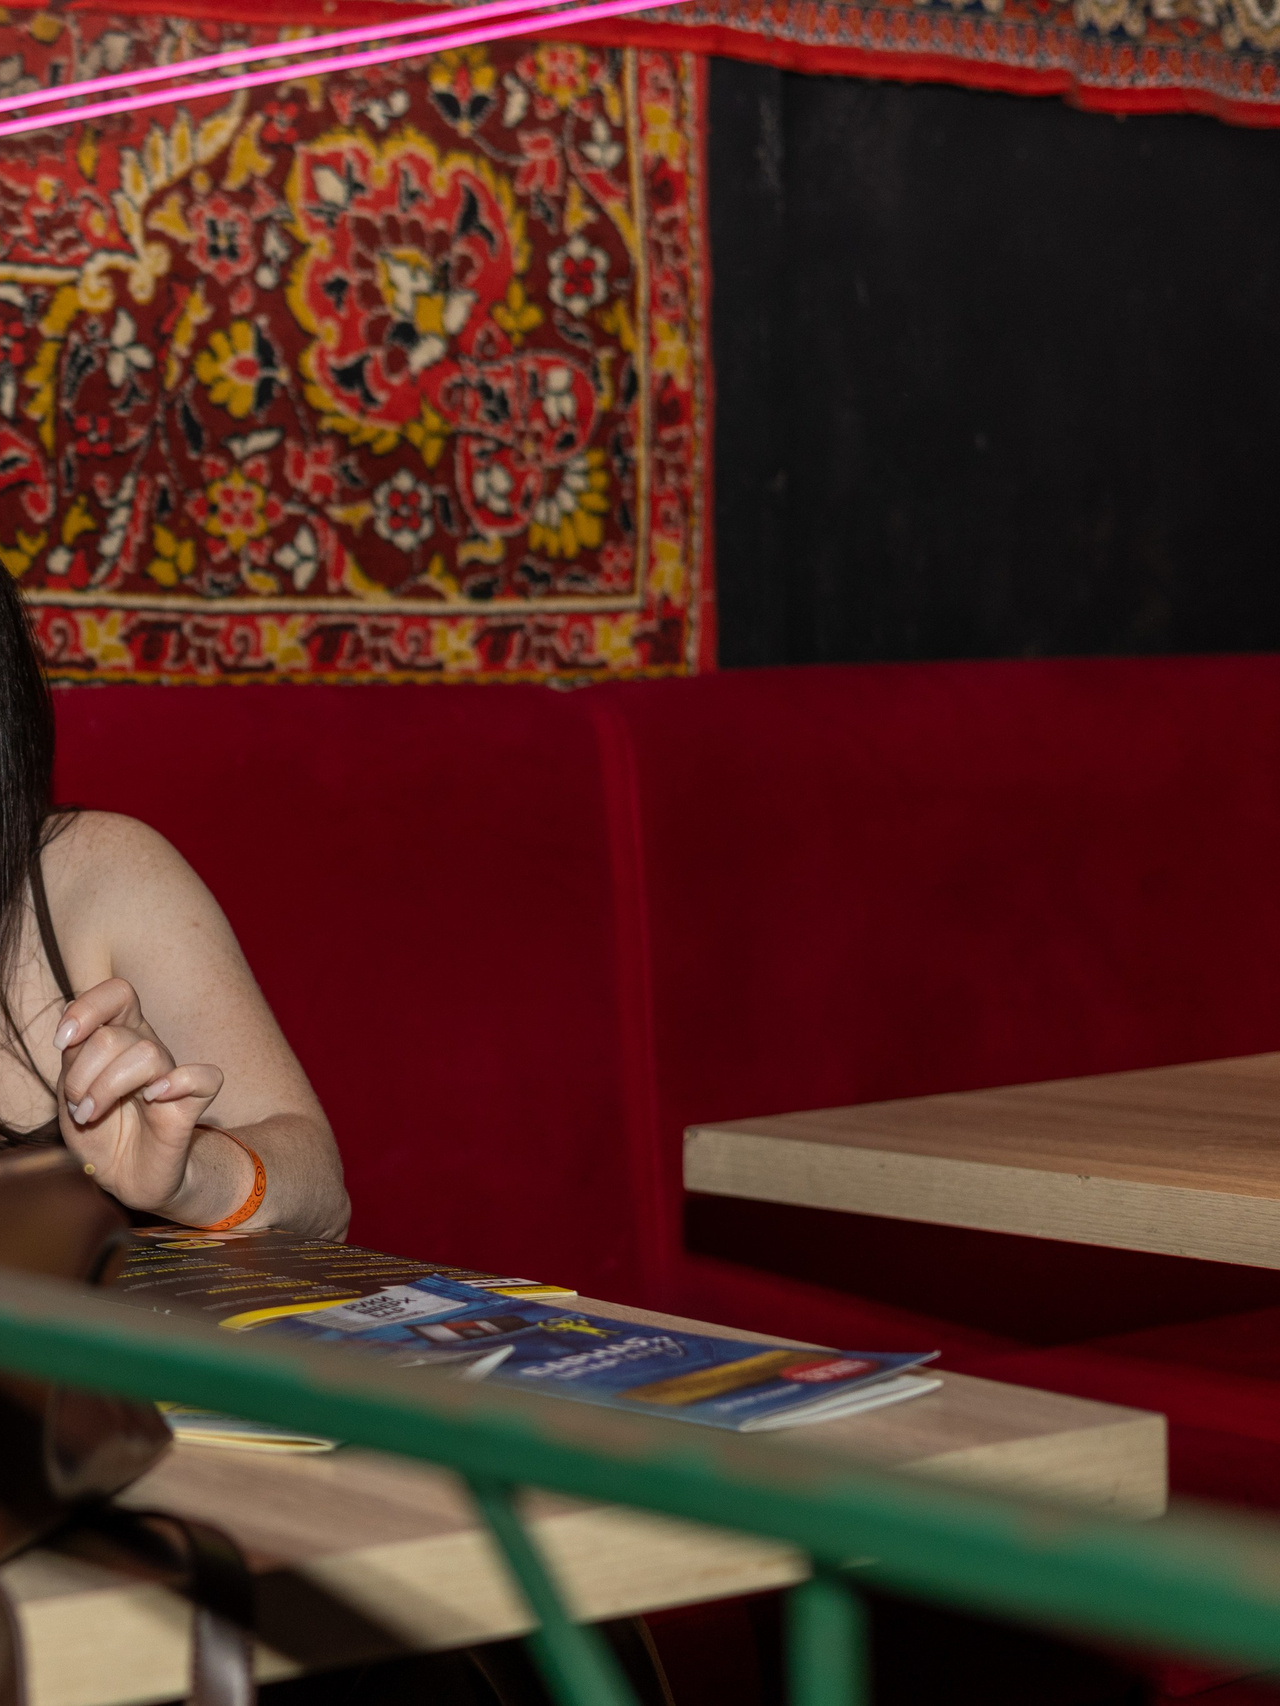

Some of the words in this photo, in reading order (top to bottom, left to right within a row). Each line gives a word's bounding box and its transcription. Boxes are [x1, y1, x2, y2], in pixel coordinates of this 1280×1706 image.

[342, 1296, 394, 1311] РУКИ
[357, 1297, 417, 1315] ВВЕРХ
[370, 1306, 406, 1318] БАР
